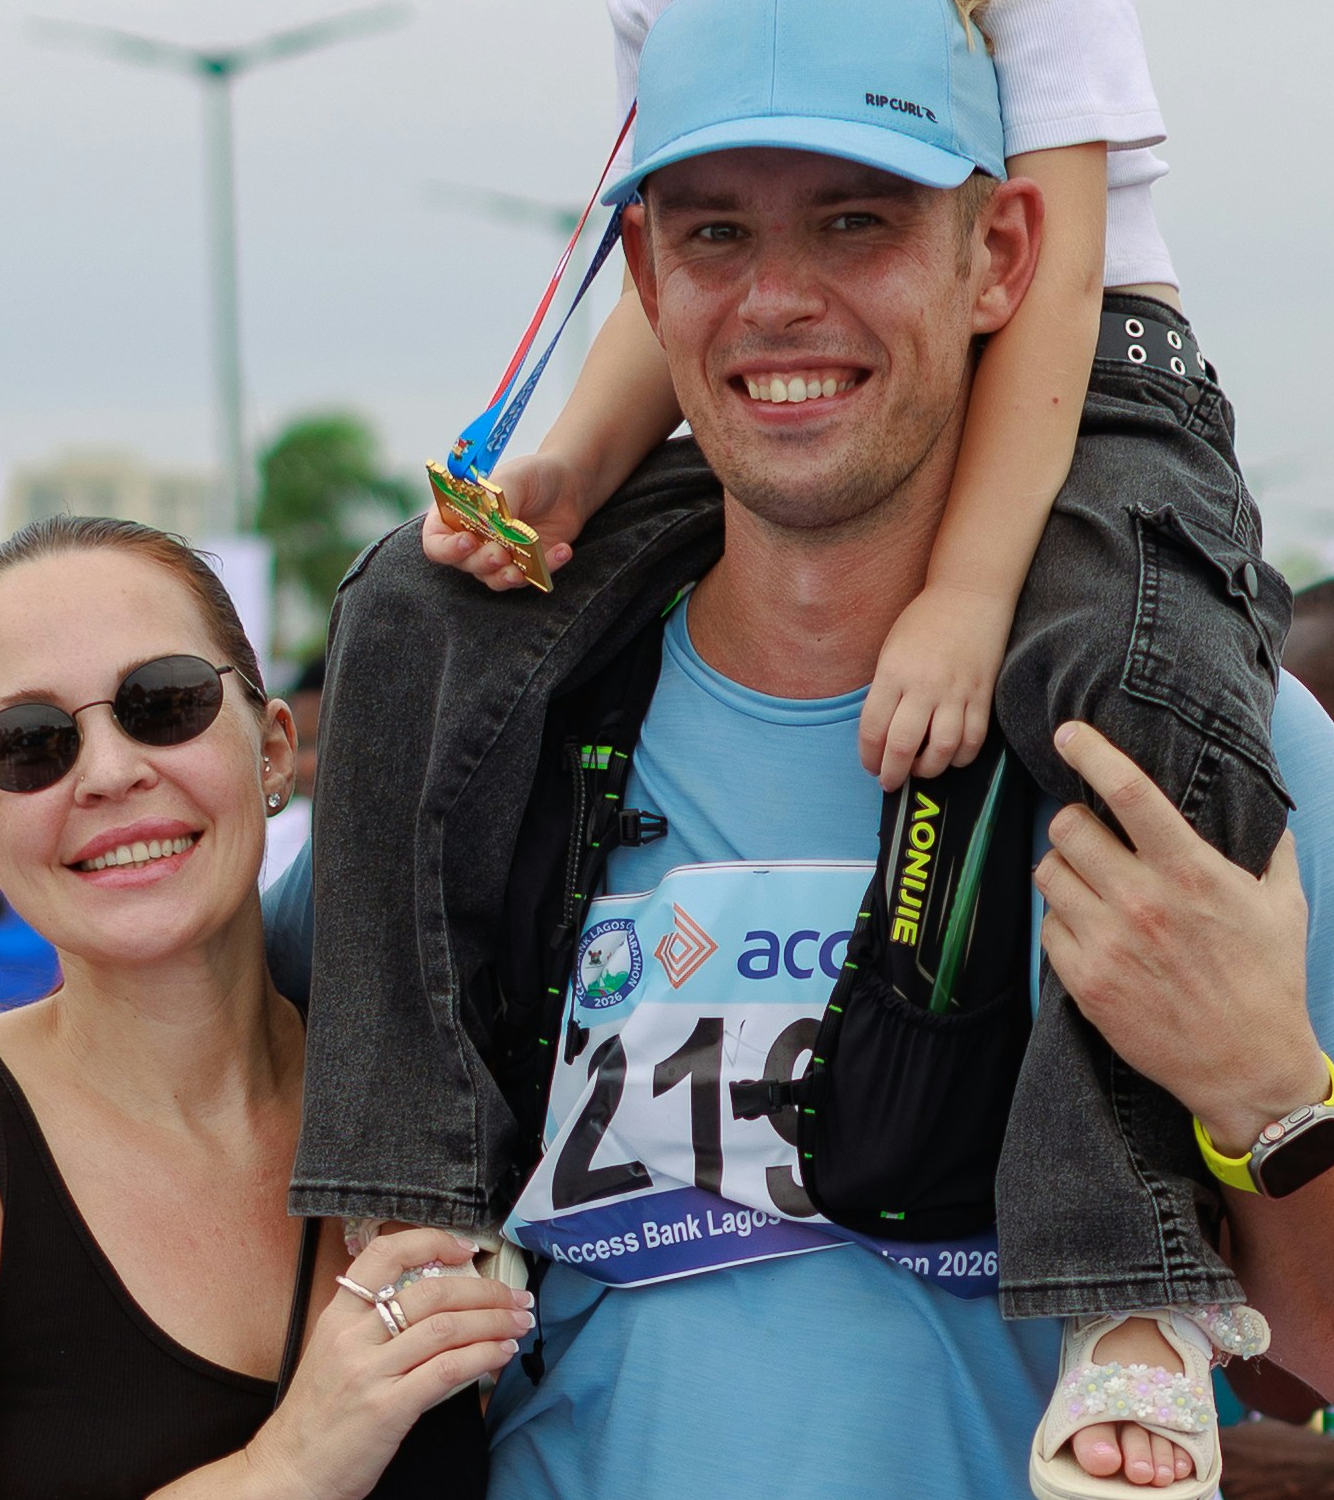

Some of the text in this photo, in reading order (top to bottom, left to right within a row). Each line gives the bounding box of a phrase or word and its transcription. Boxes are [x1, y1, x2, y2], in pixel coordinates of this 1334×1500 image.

[865, 92, 924, 118] RIP CURL
[890, 791, 940, 947] AONIJIE
[589, 920, 626, 939] LAGOS
[736, 929, 855, 980] acc
[594, 991, 623, 1008] 2026
[551, 1017, 827, 1218] 219
[552, 1231, 640, 1264] Access
[642, 1213, 702, 1249] Bank
[937, 1250, 998, 1277] 2026
